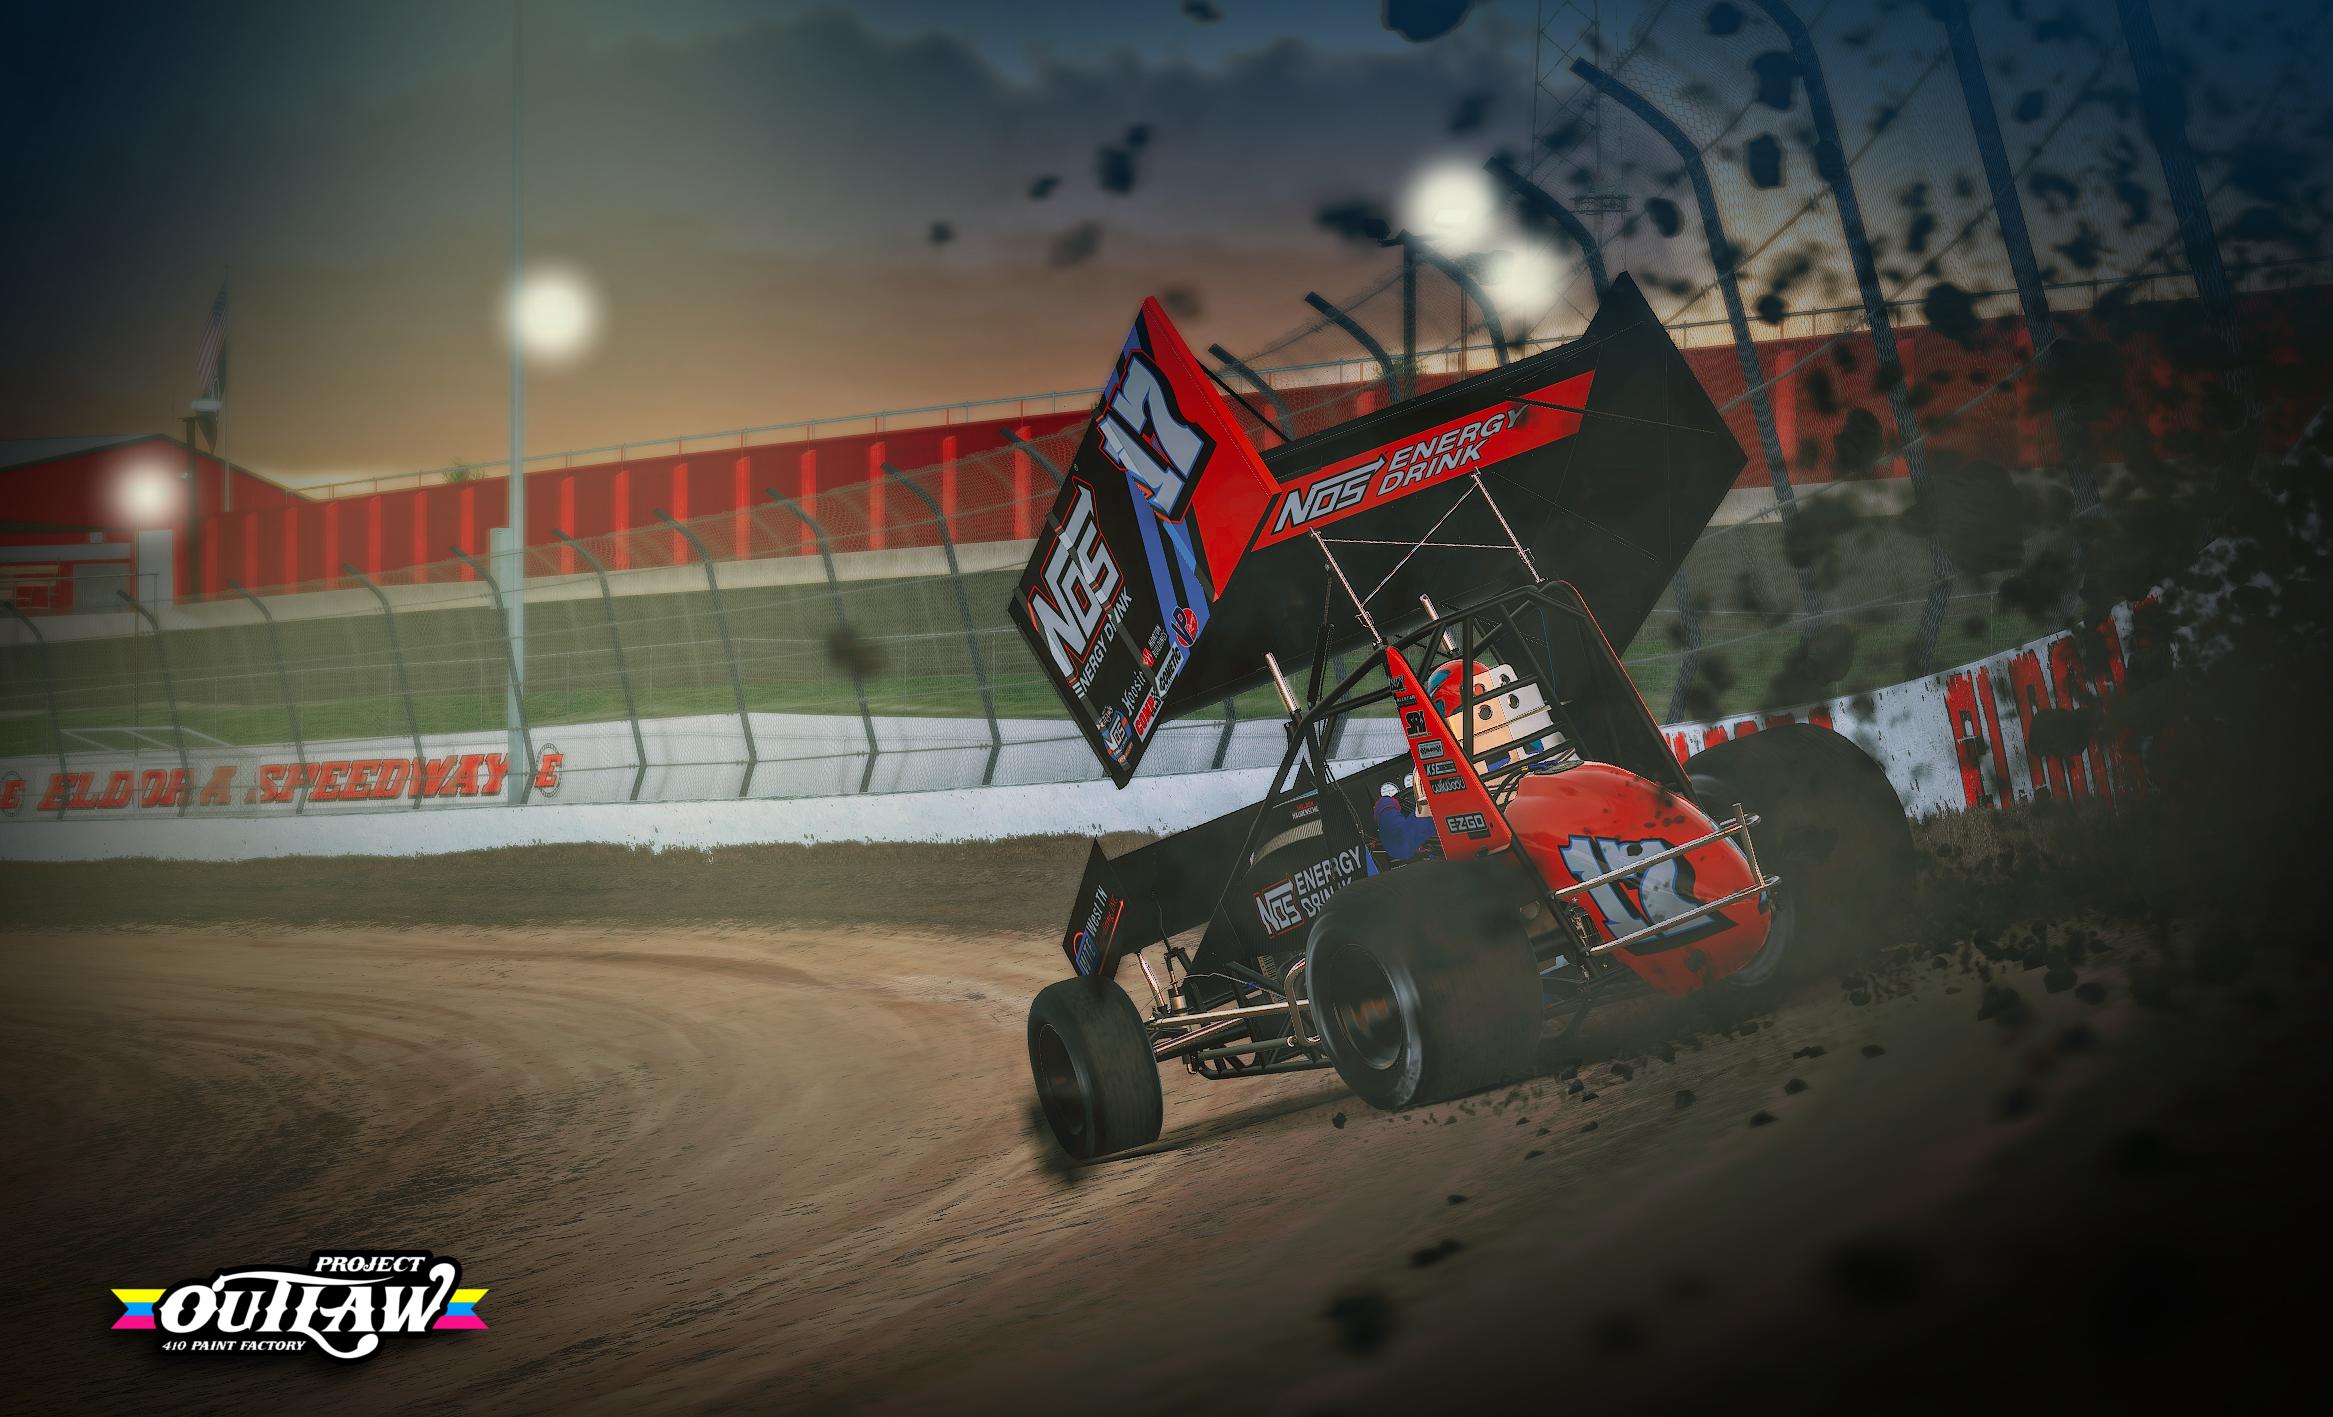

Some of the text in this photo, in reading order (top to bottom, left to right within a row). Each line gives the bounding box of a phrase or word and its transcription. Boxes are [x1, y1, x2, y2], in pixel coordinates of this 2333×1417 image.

[1100, 355, 1205, 517] 17
[1274, 404, 1529, 533] NOS ENERGY
[1377, 439, 1489, 497] DRINK
[1031, 484, 1121, 679] NOS
[244, 752, 511, 804] SPEEDWAY
[1255, 845, 1361, 936] NOS ENERGY
[1559, 833, 1718, 943] 17
